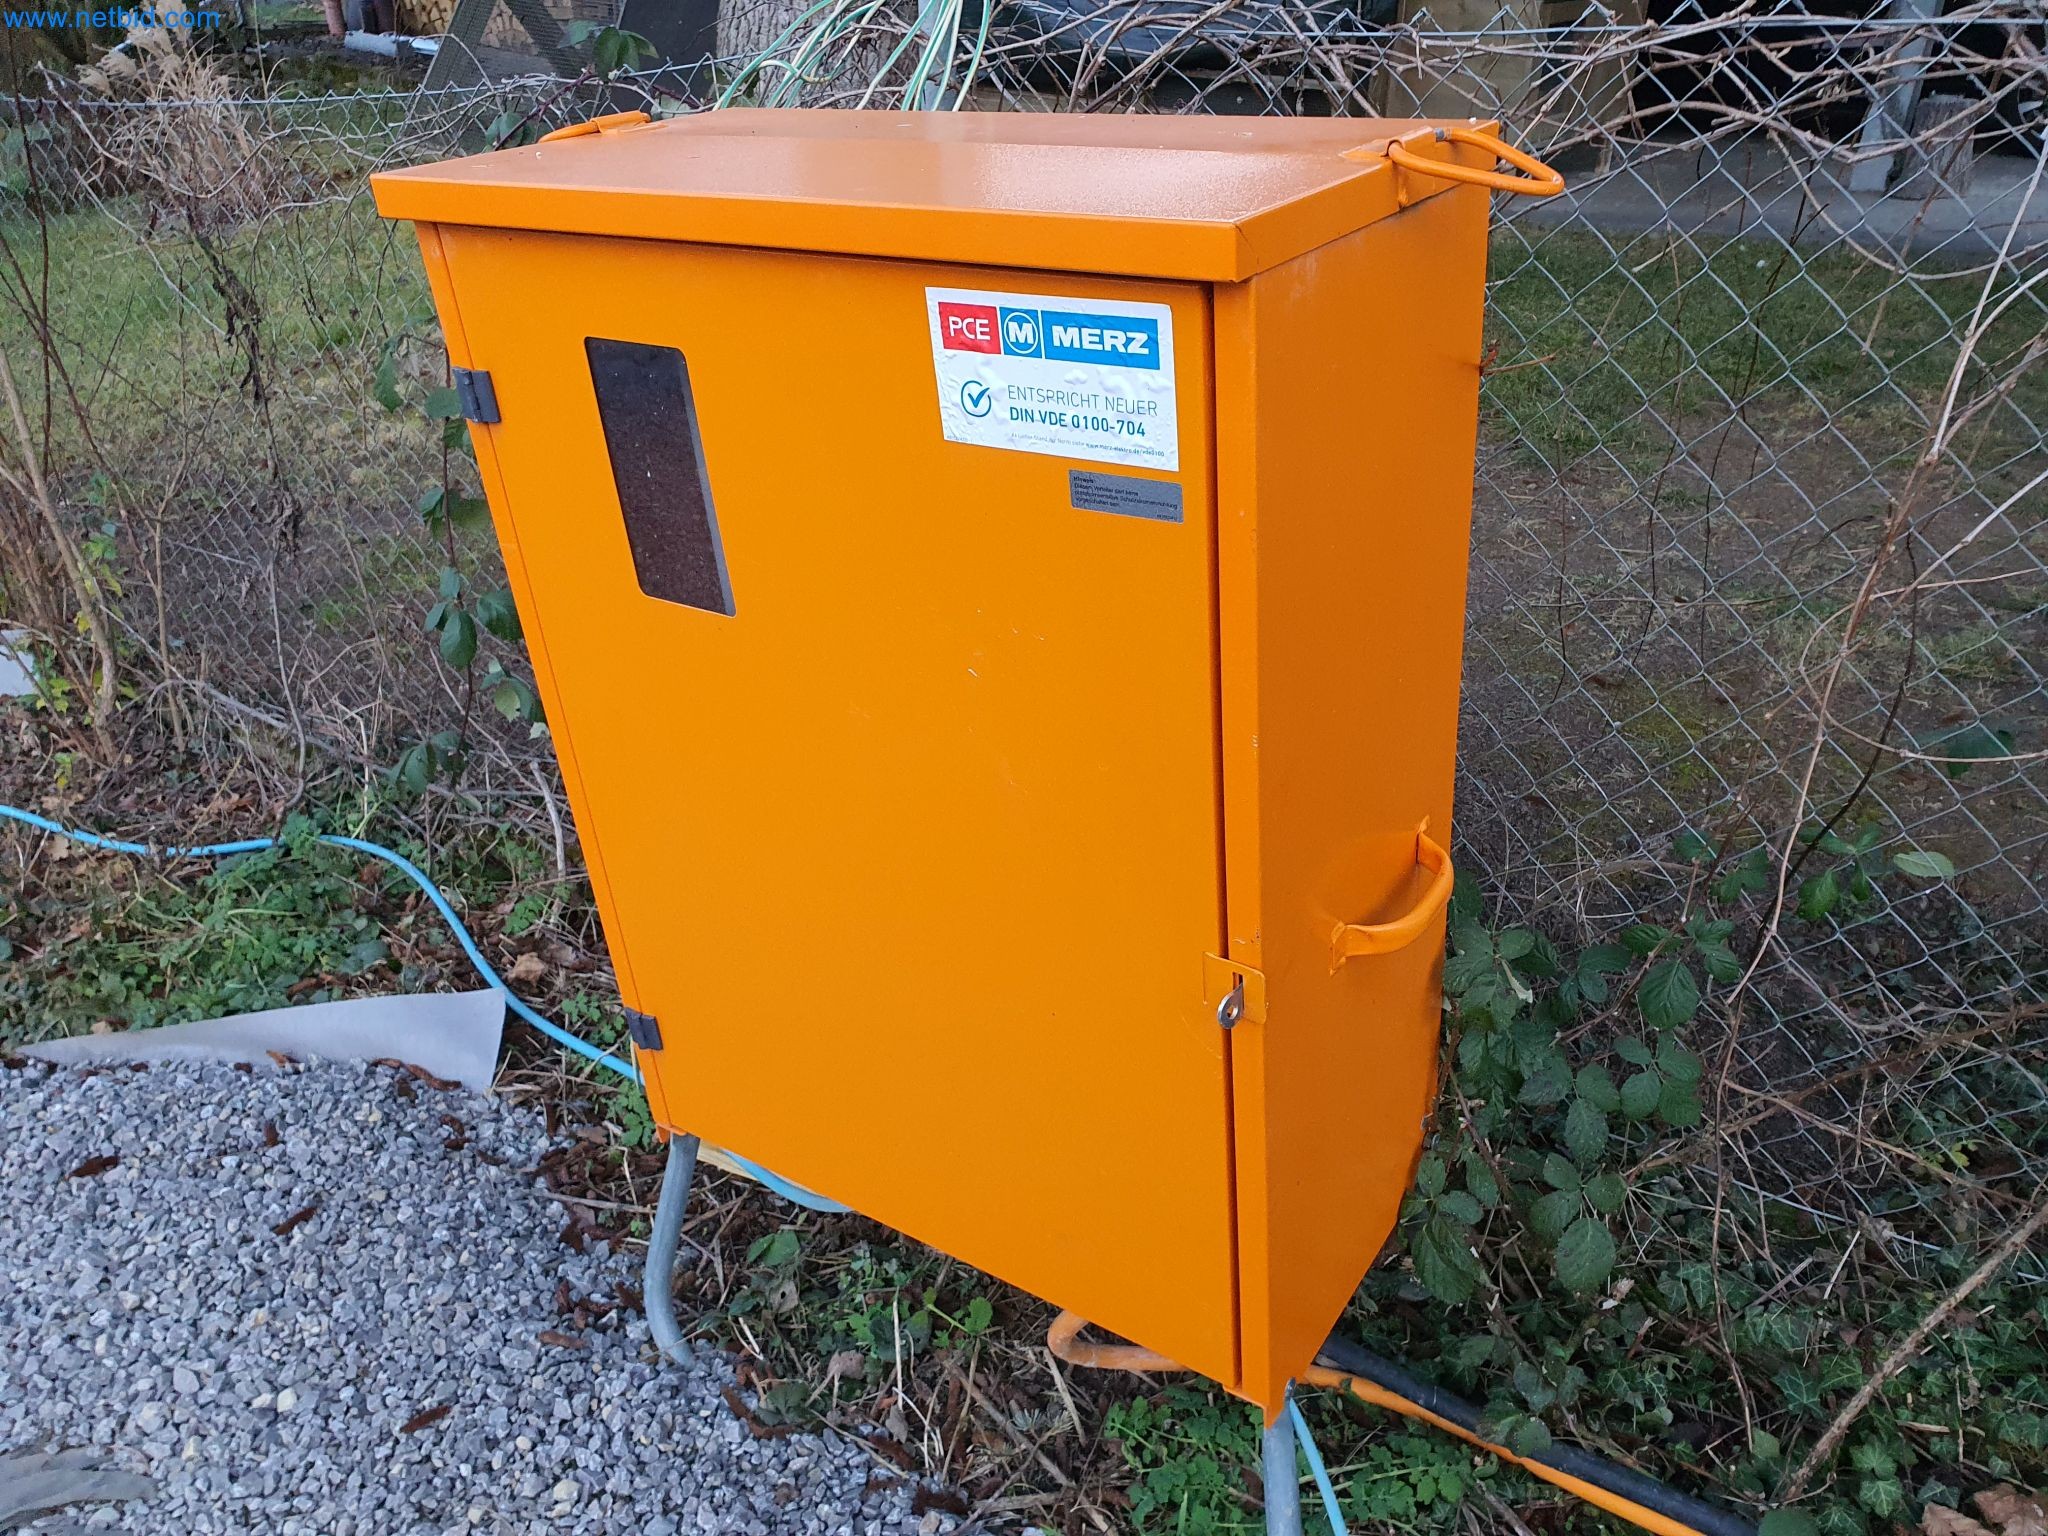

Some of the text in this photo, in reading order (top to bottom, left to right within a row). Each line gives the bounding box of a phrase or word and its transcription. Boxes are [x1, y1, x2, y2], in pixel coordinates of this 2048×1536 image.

[949, 316, 1150, 355] PCE M MERZ
[1007, 385, 1159, 417] ENTSPRICHT NEUER
[1009, 406, 1146, 437] DIN VDE 0100-704
